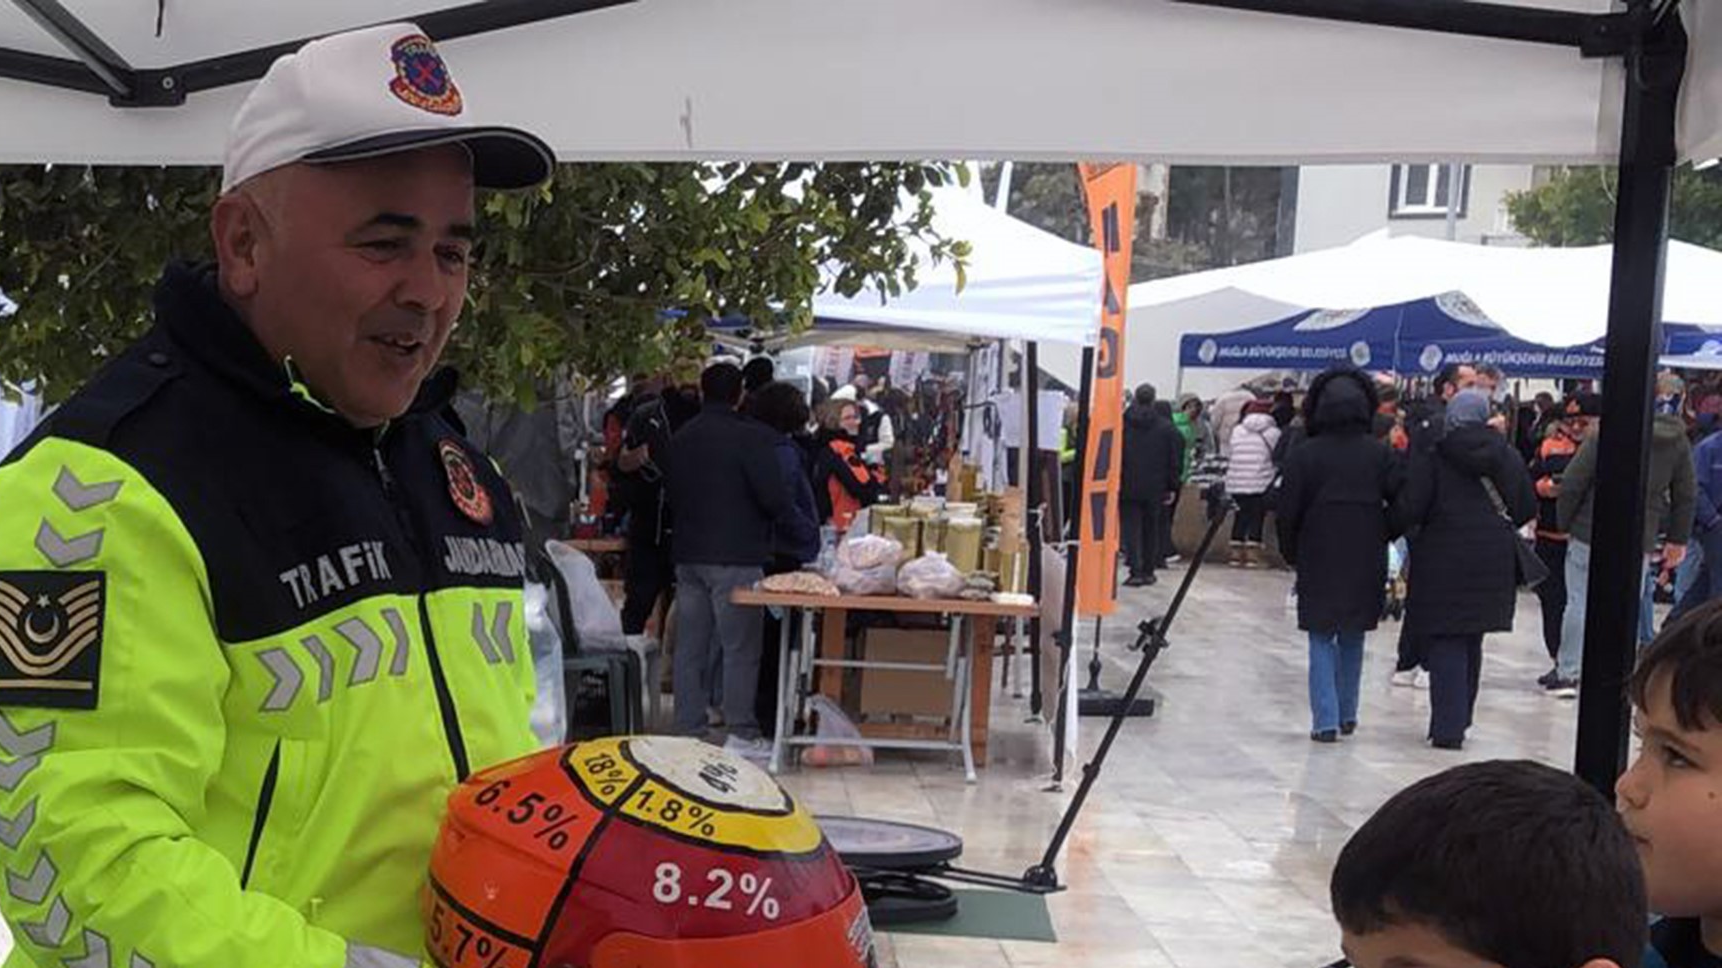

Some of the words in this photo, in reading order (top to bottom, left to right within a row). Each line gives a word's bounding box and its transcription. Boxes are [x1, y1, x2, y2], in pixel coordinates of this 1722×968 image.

[279, 541, 392, 609] TRAFİK
[475, 780, 579, 851] 6.5%
[636, 788, 716, 837] 1.8%
[652, 862, 780, 920] 8.2%
